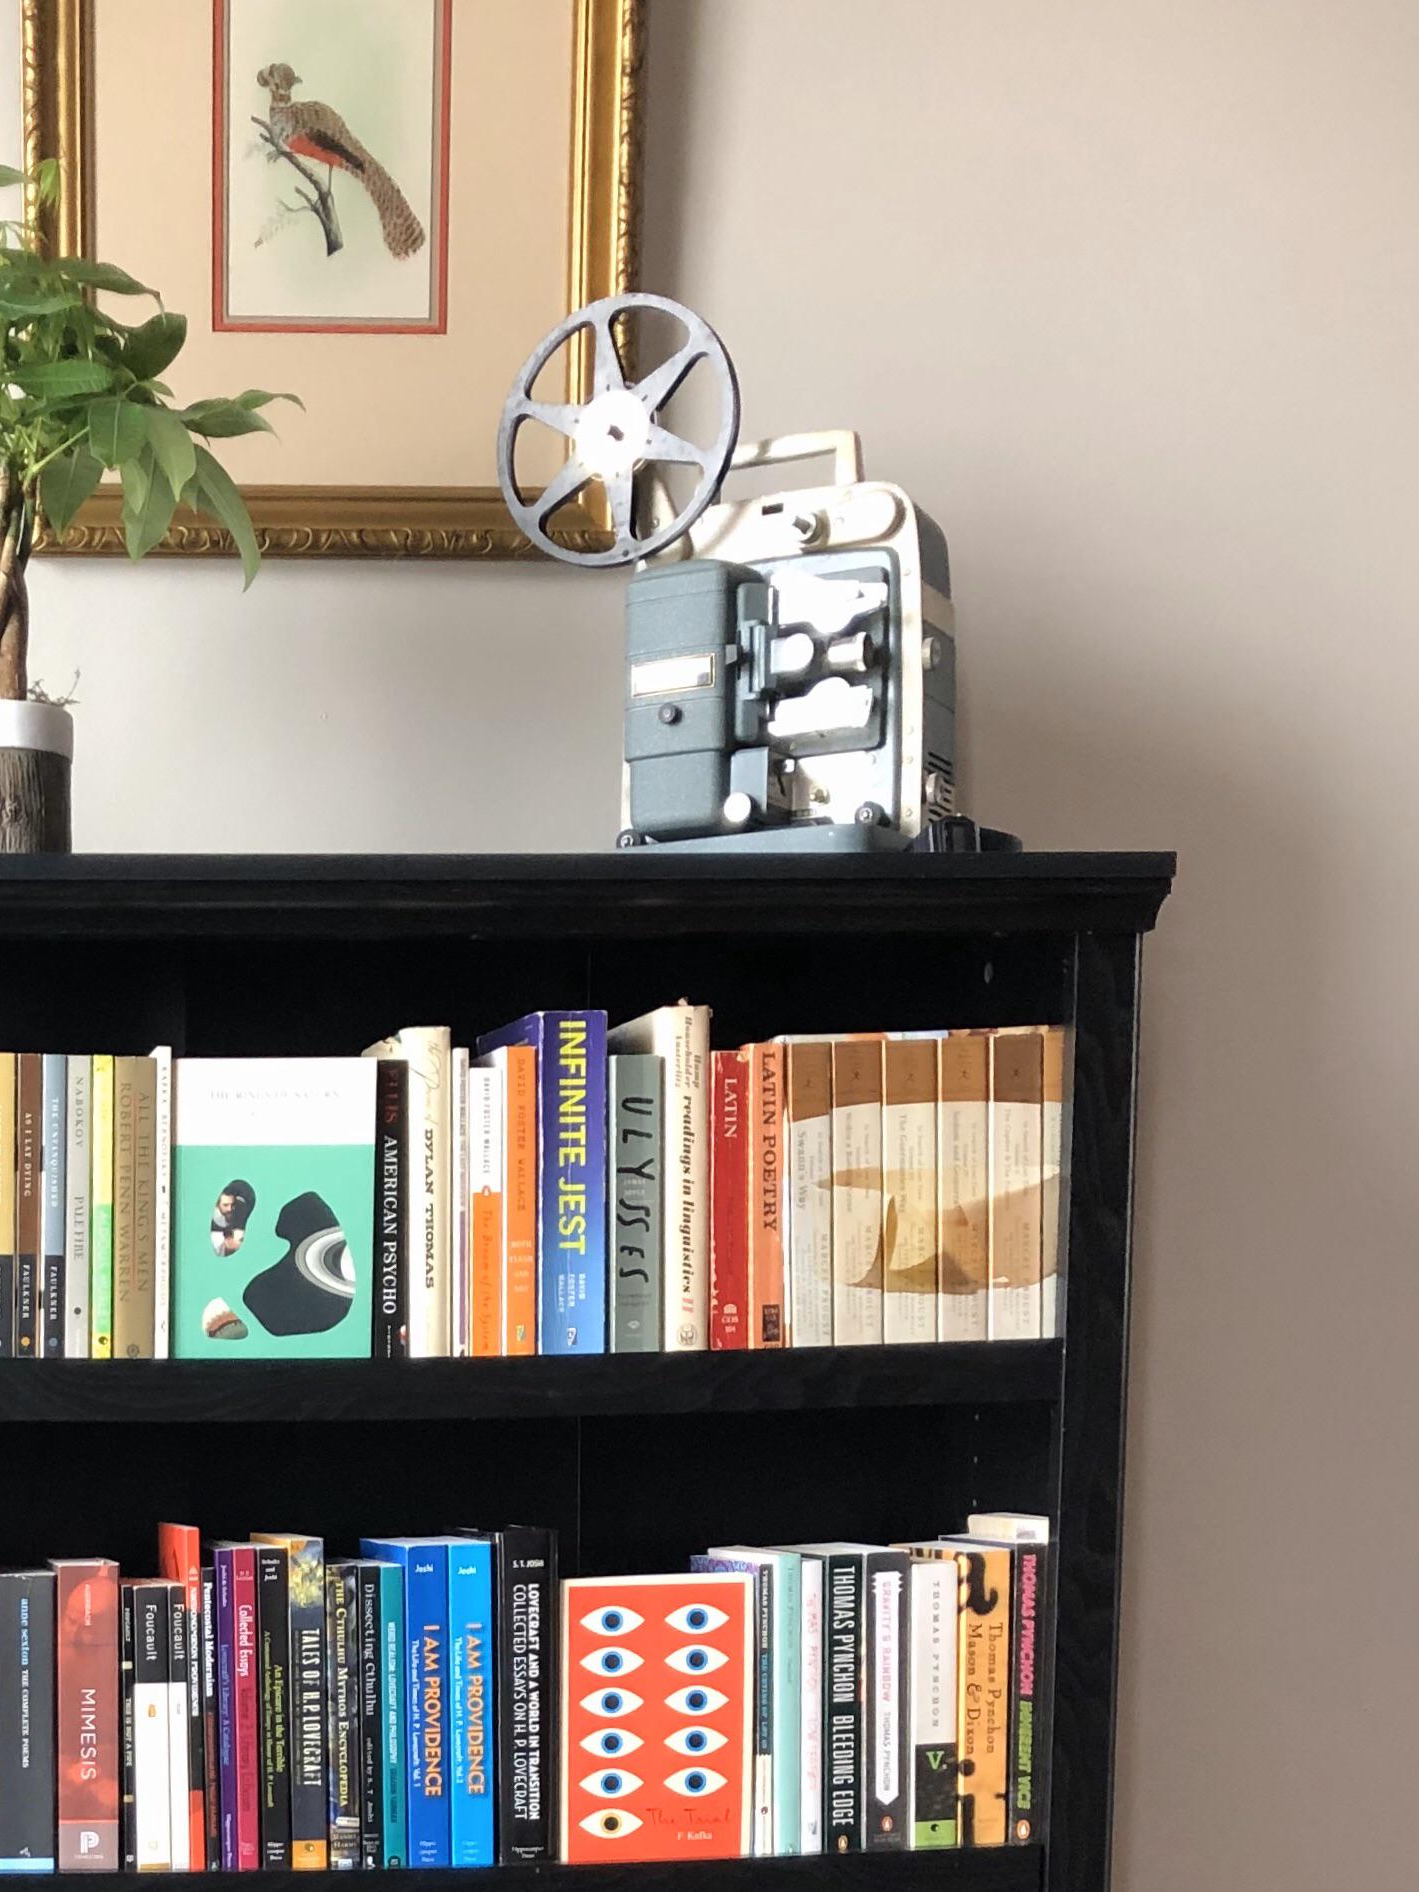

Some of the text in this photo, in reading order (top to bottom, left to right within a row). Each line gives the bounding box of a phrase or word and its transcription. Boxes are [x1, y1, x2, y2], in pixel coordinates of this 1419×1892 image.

[74, 1077, 84, 1148] NABOKOV
[137, 1090, 150, 1122] ALL
[517, 1058, 526, 1212] DAVID FOSTER WALLACE
[558, 1020, 587, 1255] INFINITE JEST
[680, 1096, 695, 1174] readings
[724, 1078, 738, 1139] LATIN
[137, 1134, 150, 1168] THE
[763, 1052, 778, 1232] LATIN POETRY
[796, 1131, 809, 1210] Swann's Way
[119, 1082, 133, 1302] ROBERT PENN WARREN
[424, 1129, 435, 1289] DYLAN THOMAS
[617, 1096, 655, 1283] ULYSSES
[680, 1179, 695, 1195] in
[74, 1196, 84, 1260] PALE FIRE
[382, 1135, 398, 1314] AMERICAN PSYCHO
[680, 1200, 695, 1293] linguistics
[21, 1264, 31, 1319] FAULKNER
[49, 1266, 57, 1320] FAULKNER
[137, 1254, 150, 1292] MEN
[21, 1629, 30, 1665] sexton
[145, 1604, 157, 1661] Foucault
[173, 1603, 186, 1661] Foucault
[204, 1582, 215, 1697] Pentecostal Modernism
[237, 1604, 251, 1646] Collected
[302, 1629, 322, 1666] TALES
[363, 1584, 377, 1715] Dissecting Cthulhu
[528, 1583, 540, 1651] LOVECRAFT
[21, 1670, 30, 1686] THE
[237, 1649, 251, 1677] Essays
[302, 1670, 322, 1686] OF
[424, 1637, 439, 1670] AM
[467, 1636, 484, 1668] AM
[528, 1654, 540, 1677] AND
[932, 1581, 941, 1729] THOMAS PYNCHON
[1016, 1554, 1036, 1809] THOMAS PYNCHON INHERENT VICE
[21, 1689, 30, 1736] COMPLETE
[335, 1581, 350, 1807] THE CTHULHU MYTHOS ENCYCLOPEDIA
[513, 1584, 527, 1819] COLLECTED ESSAYS ON H. P. LOVECRAFT
[528, 1691, 540, 1732] WORLD
[832, 1566, 855, 1826] THOMAS PYNCHON BLEEDING EDGE
[966, 1623, 982, 1754] Mason & Dixon
[985, 1622, 1003, 1753] Thomas Pynchon
[21, 1738, 30, 1768] POEMS
[79, 1688, 97, 1780] MIMESIS
[302, 1716, 322, 1786] LOVECRAFT
[425, 1677, 441, 1796] PROVIDENCE
[467, 1675, 484, 1794] PROVIDENCE
[528, 1736, 540, 1747] IN
[528, 1751, 540, 1820] TRANSITION
[687, 1831, 712, 1840] Kafka
